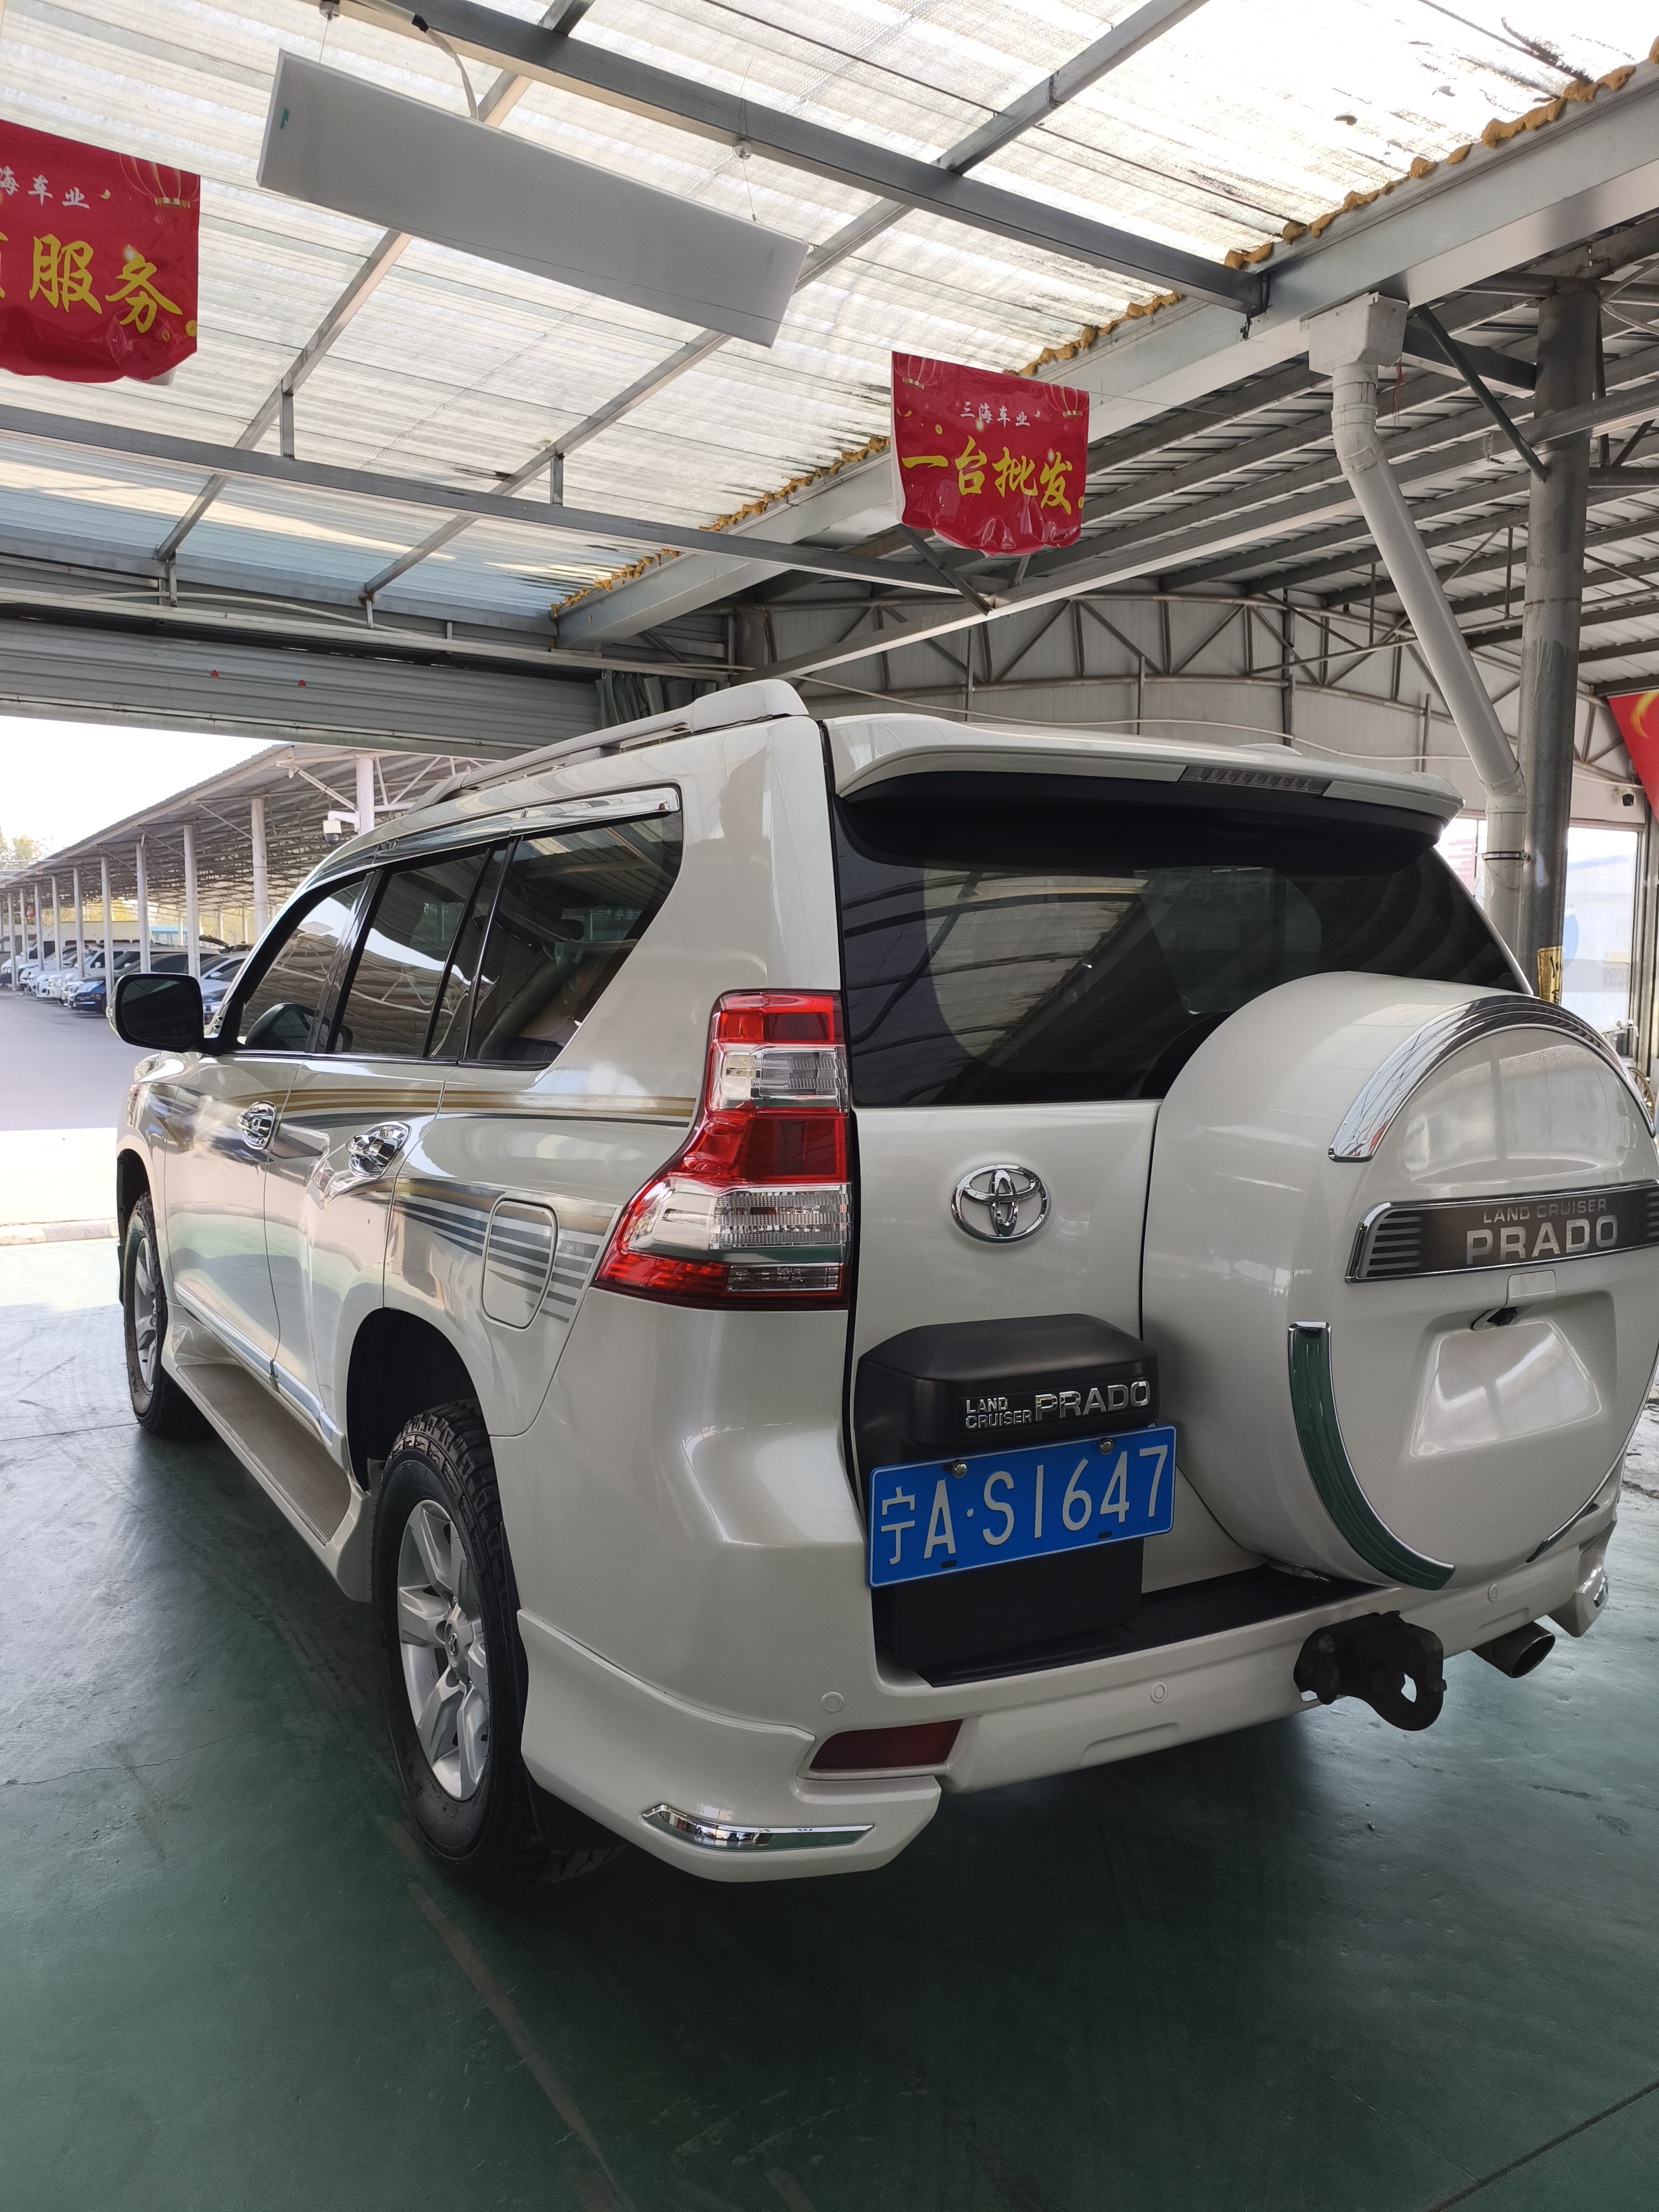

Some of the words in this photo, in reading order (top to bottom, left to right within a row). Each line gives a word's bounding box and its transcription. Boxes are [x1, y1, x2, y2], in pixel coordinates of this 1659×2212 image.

[0, 233, 183, 333] 服务
[960, 401, 1030, 428] 三海车业
[901, 435, 1073, 515] 一台批发
[1483, 1207, 1530, 1224] LAND
[1536, 1198, 1607, 1218] CRUISER
[1466, 1215, 1618, 1265] PRADO
[966, 1410, 1033, 1429] CRUISER
[1035, 1380, 1151, 1421] PRADO
[966, 1397, 1008, 1414] LAND
